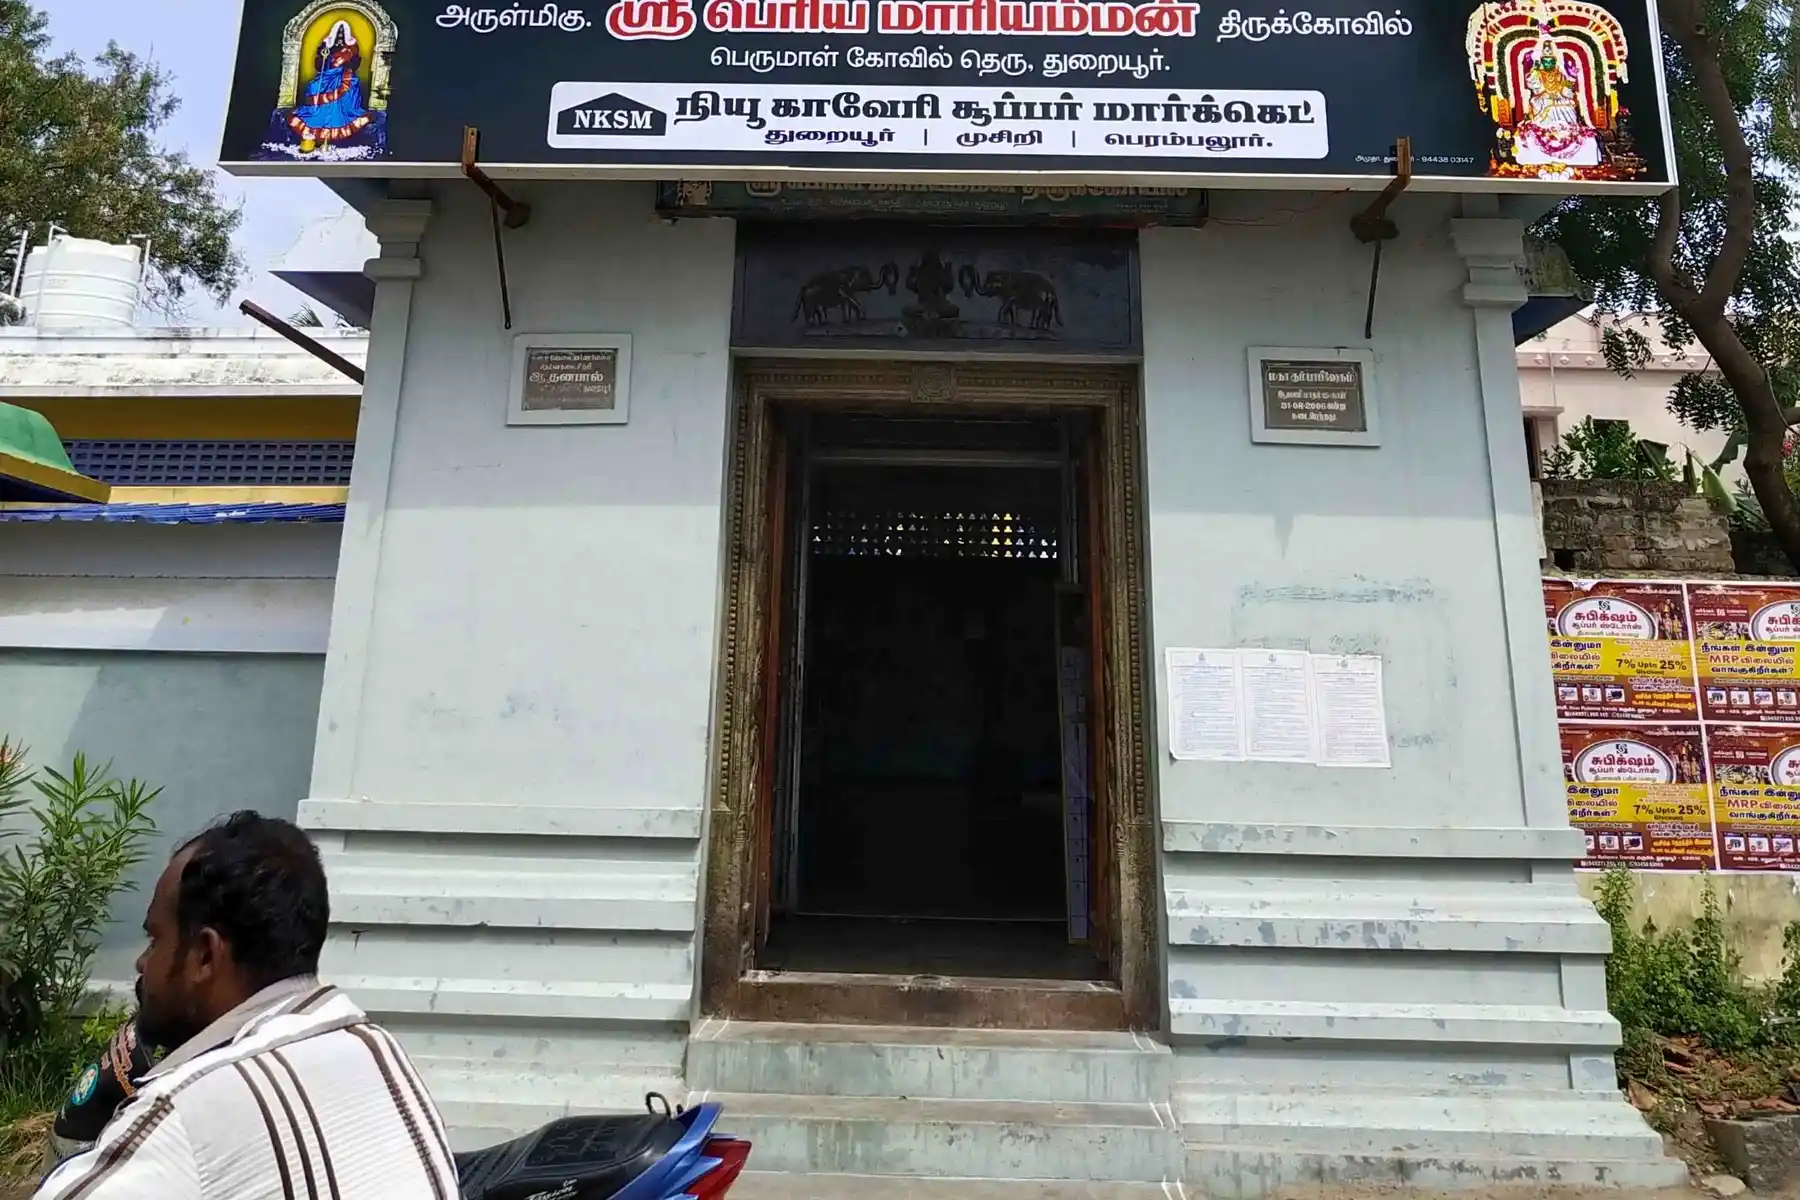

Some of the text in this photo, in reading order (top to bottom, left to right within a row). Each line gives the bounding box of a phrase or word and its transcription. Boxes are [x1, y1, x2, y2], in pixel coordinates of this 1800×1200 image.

[435, 3, 593, 33] அருள்மிகு.
[1216, 8, 1413, 42] திருக்கோவில்
[710, 45, 1171, 79] பெருமாள் கோவில் தெரு, துறையூர்.
[572, 109, 653, 130] NKSM
[673, 90, 1315, 130] நியூ காவேரி சூப்பர் மார்க்கெட்
[764, 128, 1273, 152] துறையூர் முசிறி பெரம்பலூர்.
[1616, 658, 1636, 668] 7%
[1659, 660, 1687, 670] 25%
[1709, 655, 1739, 663] MRP
[1633, 804, 1654, 815] 7%
[1678, 805, 1706, 815] 25%
[1727, 799, 1758, 809] MRP
